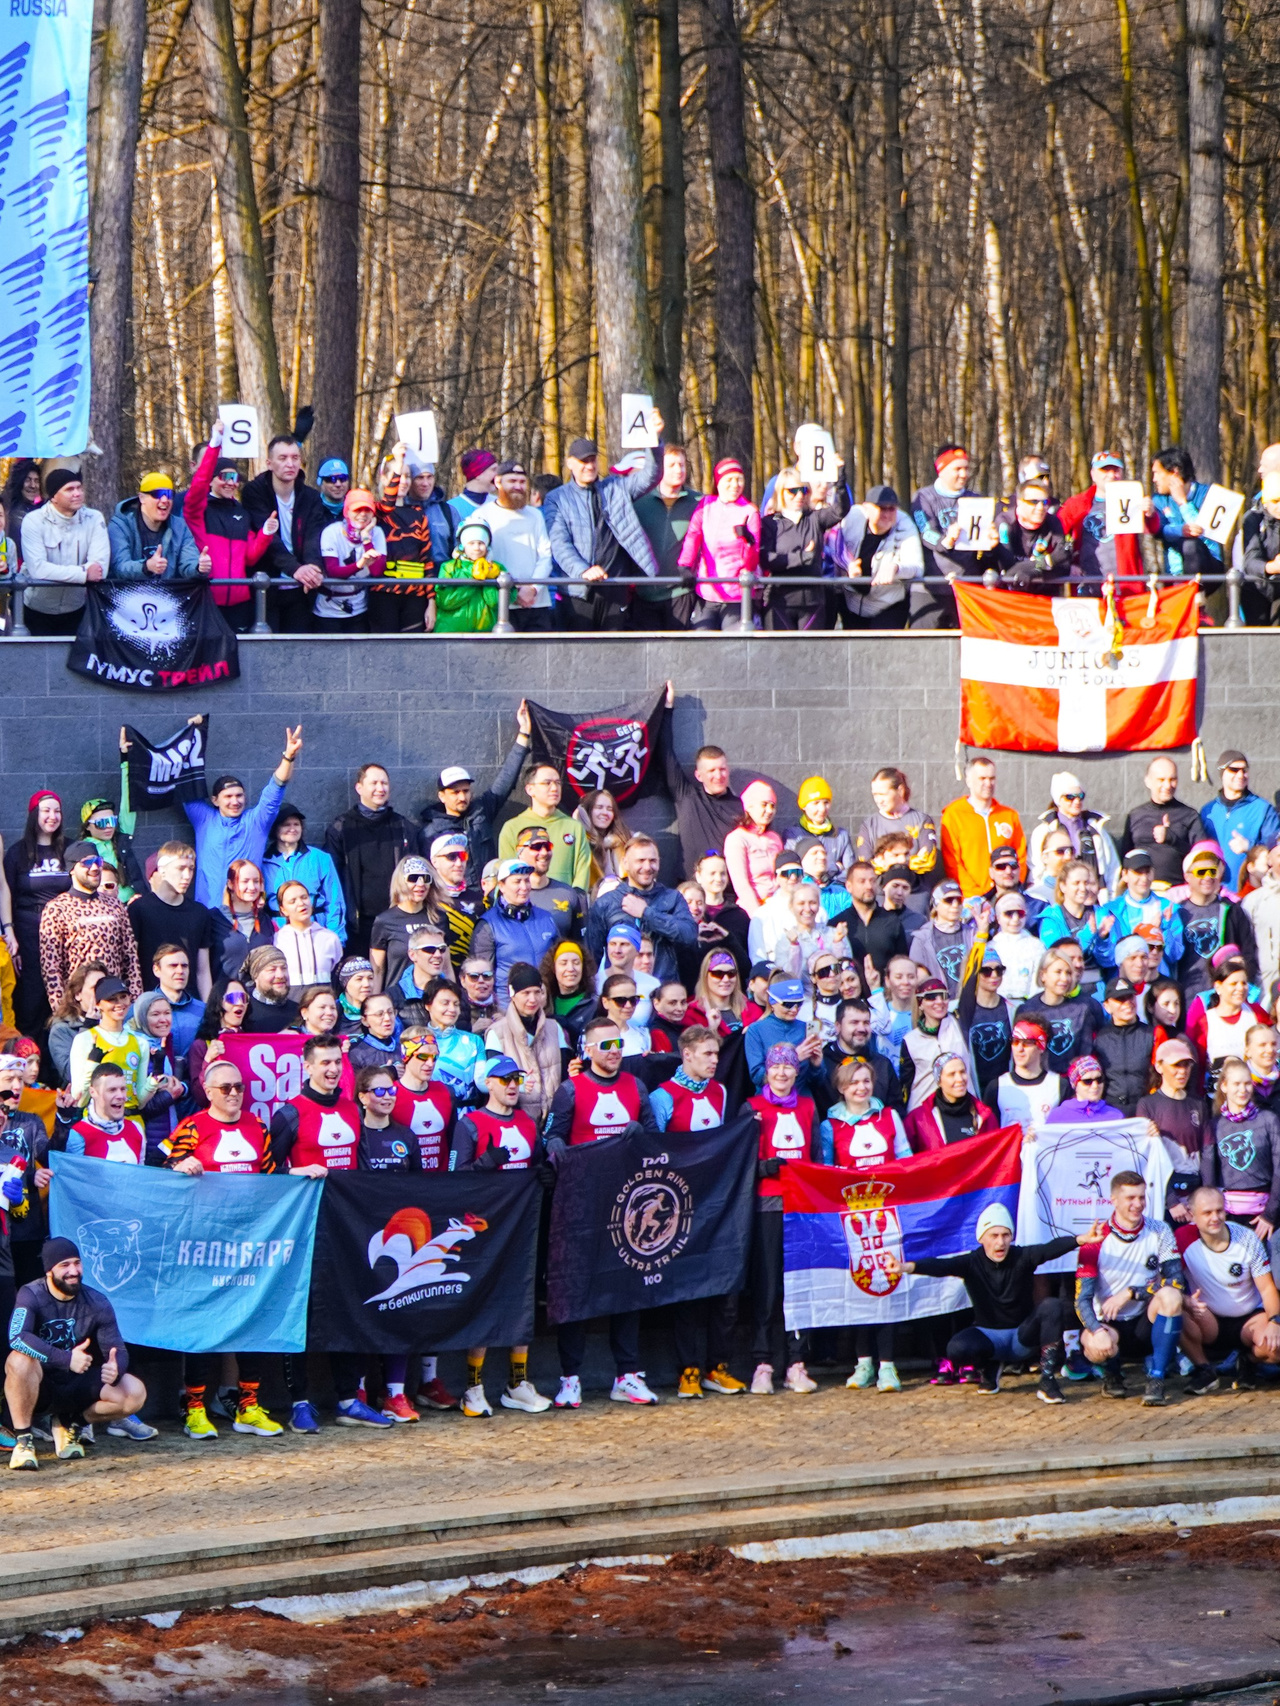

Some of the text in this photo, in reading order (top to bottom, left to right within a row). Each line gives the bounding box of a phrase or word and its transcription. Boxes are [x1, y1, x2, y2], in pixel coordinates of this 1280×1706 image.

[9, 0, 68, 17] RUSSIA
[230, 419, 252, 445] S
[628, 410, 649, 434] A
[86, 653, 155, 687] ГУМУС
[1029, 650, 1141, 669] JUNIOS
[616, 1169, 689, 1203] GOLDEN RING
[177, 1239, 295, 1268] КАПИБАРА
[618, 1236, 688, 1272] ULTRA TRAIL
[643, 1273, 662, 1286] 100
